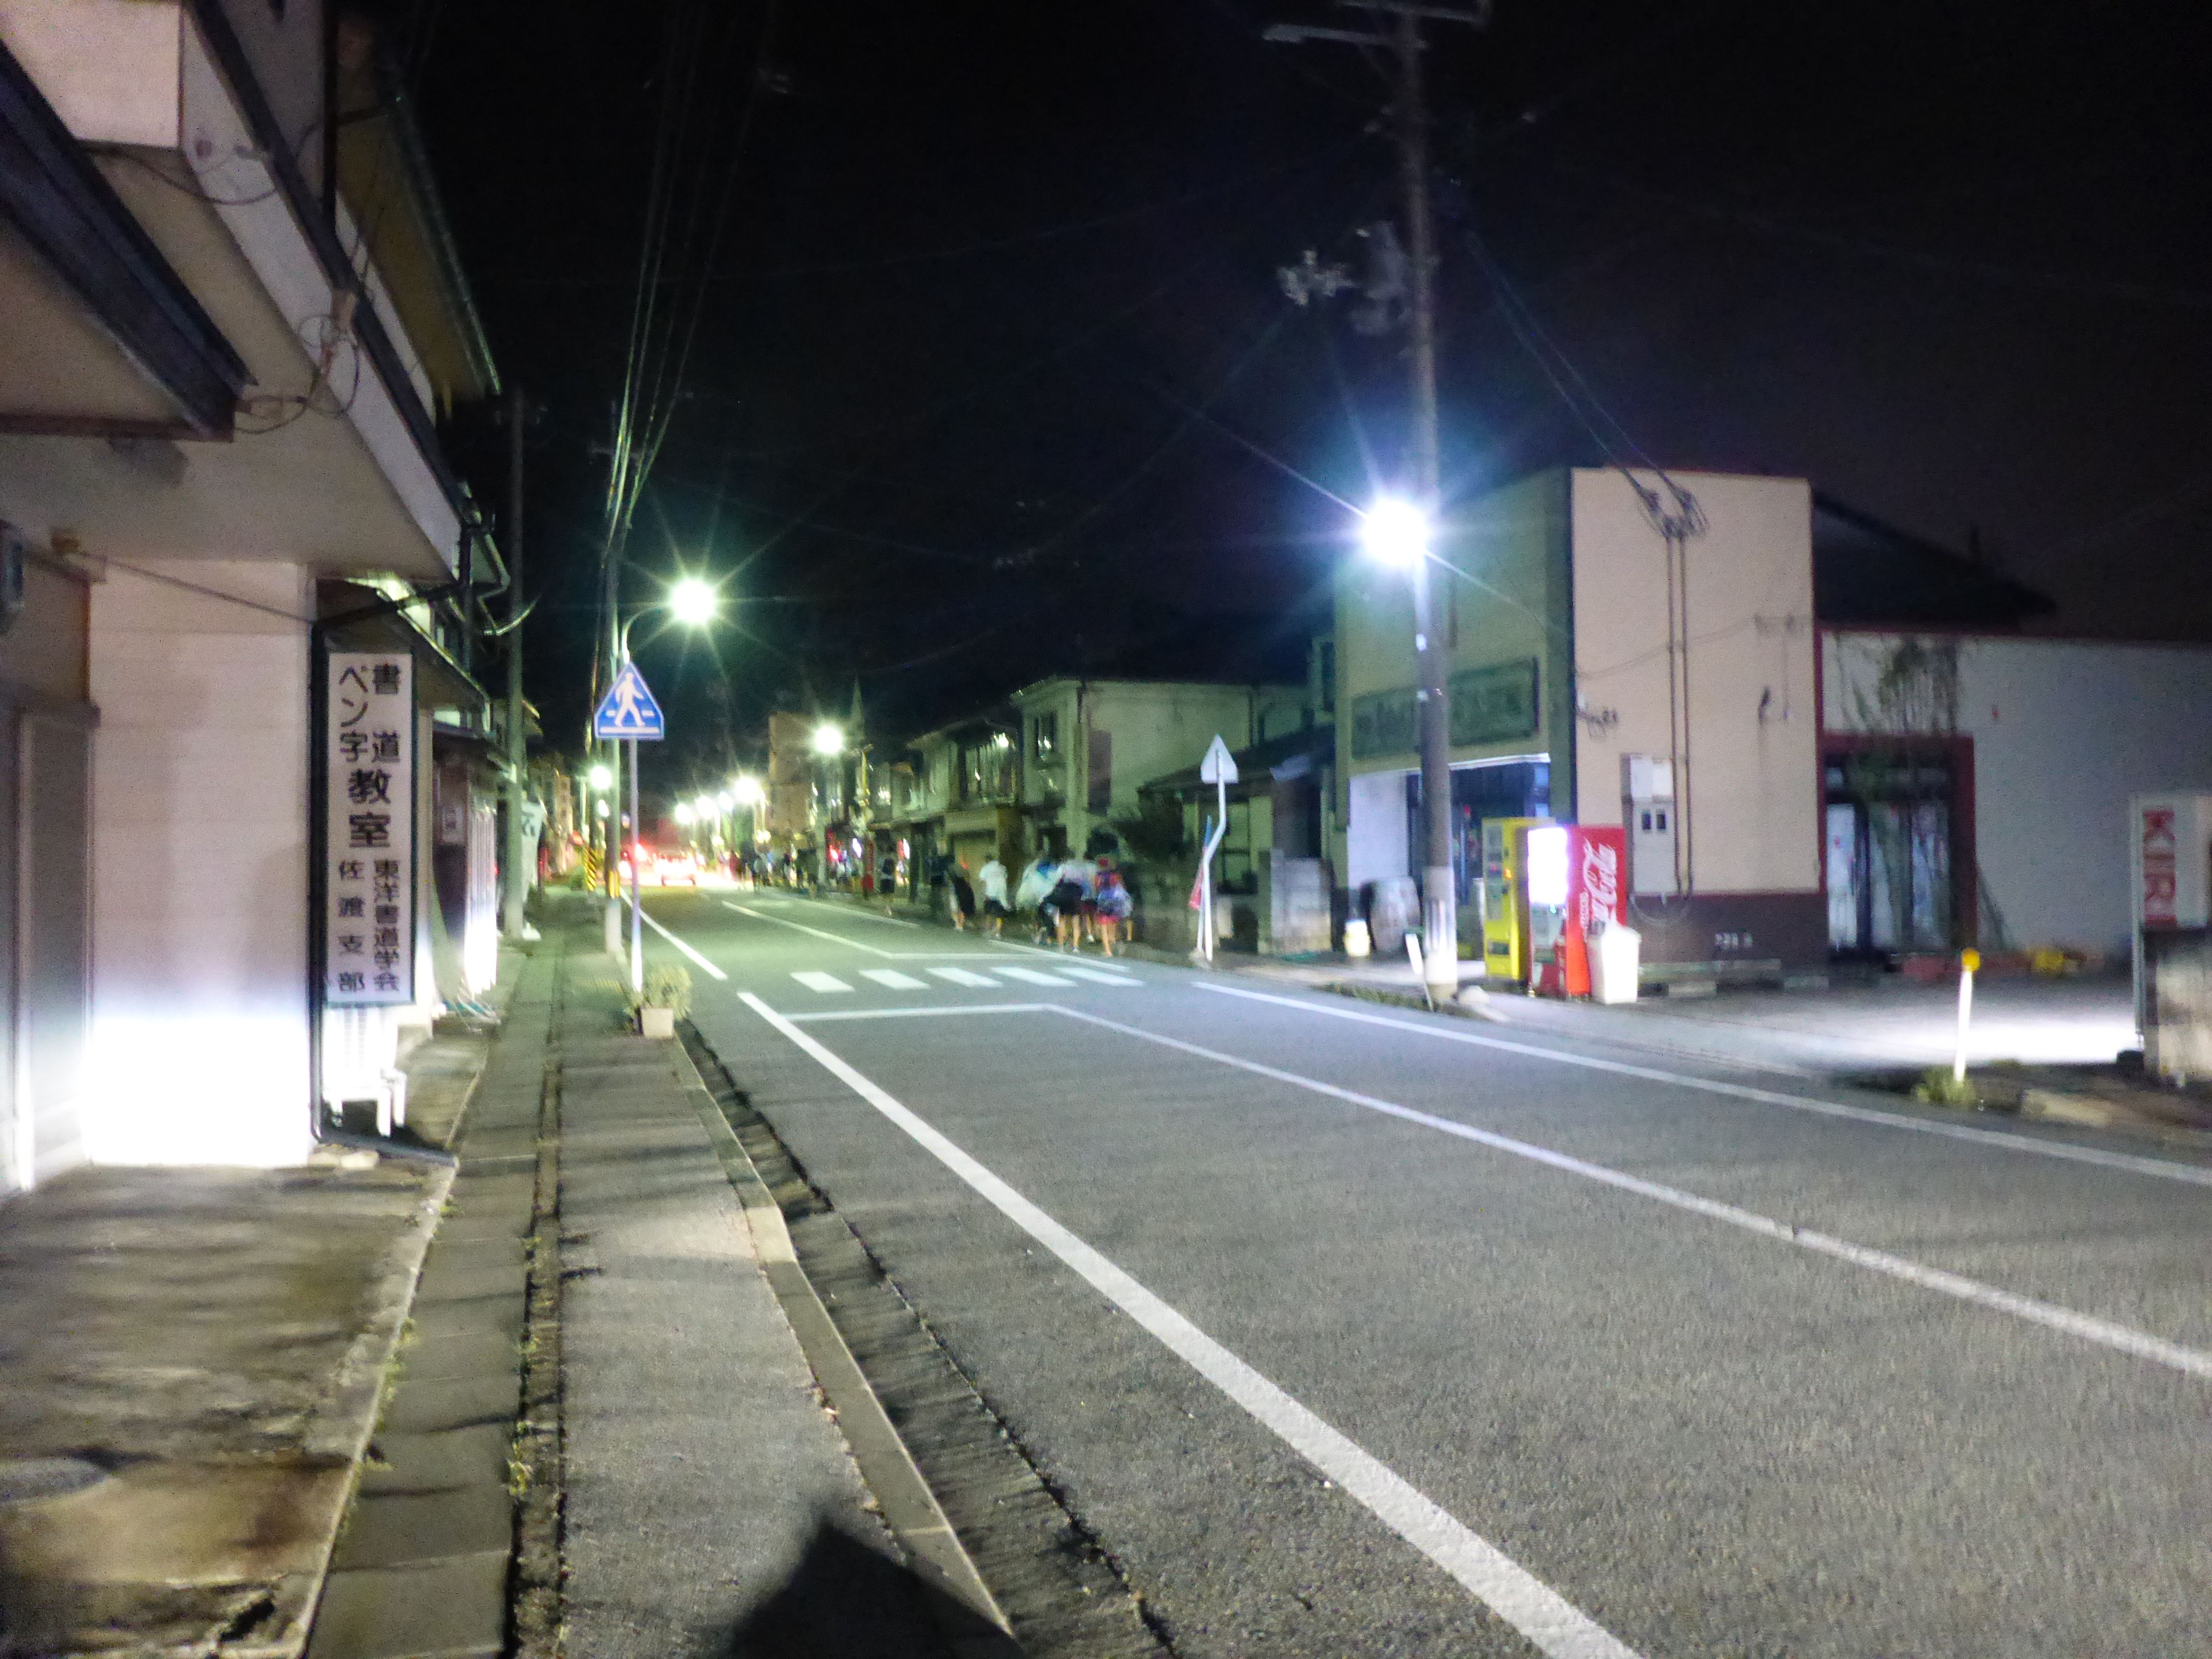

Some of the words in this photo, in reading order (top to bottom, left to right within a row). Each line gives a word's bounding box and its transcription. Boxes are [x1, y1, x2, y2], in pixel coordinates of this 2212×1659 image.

[339, 666, 368, 763] ペン字
[373, 664, 400, 763] 書道
[349, 769, 392, 847] 教室
